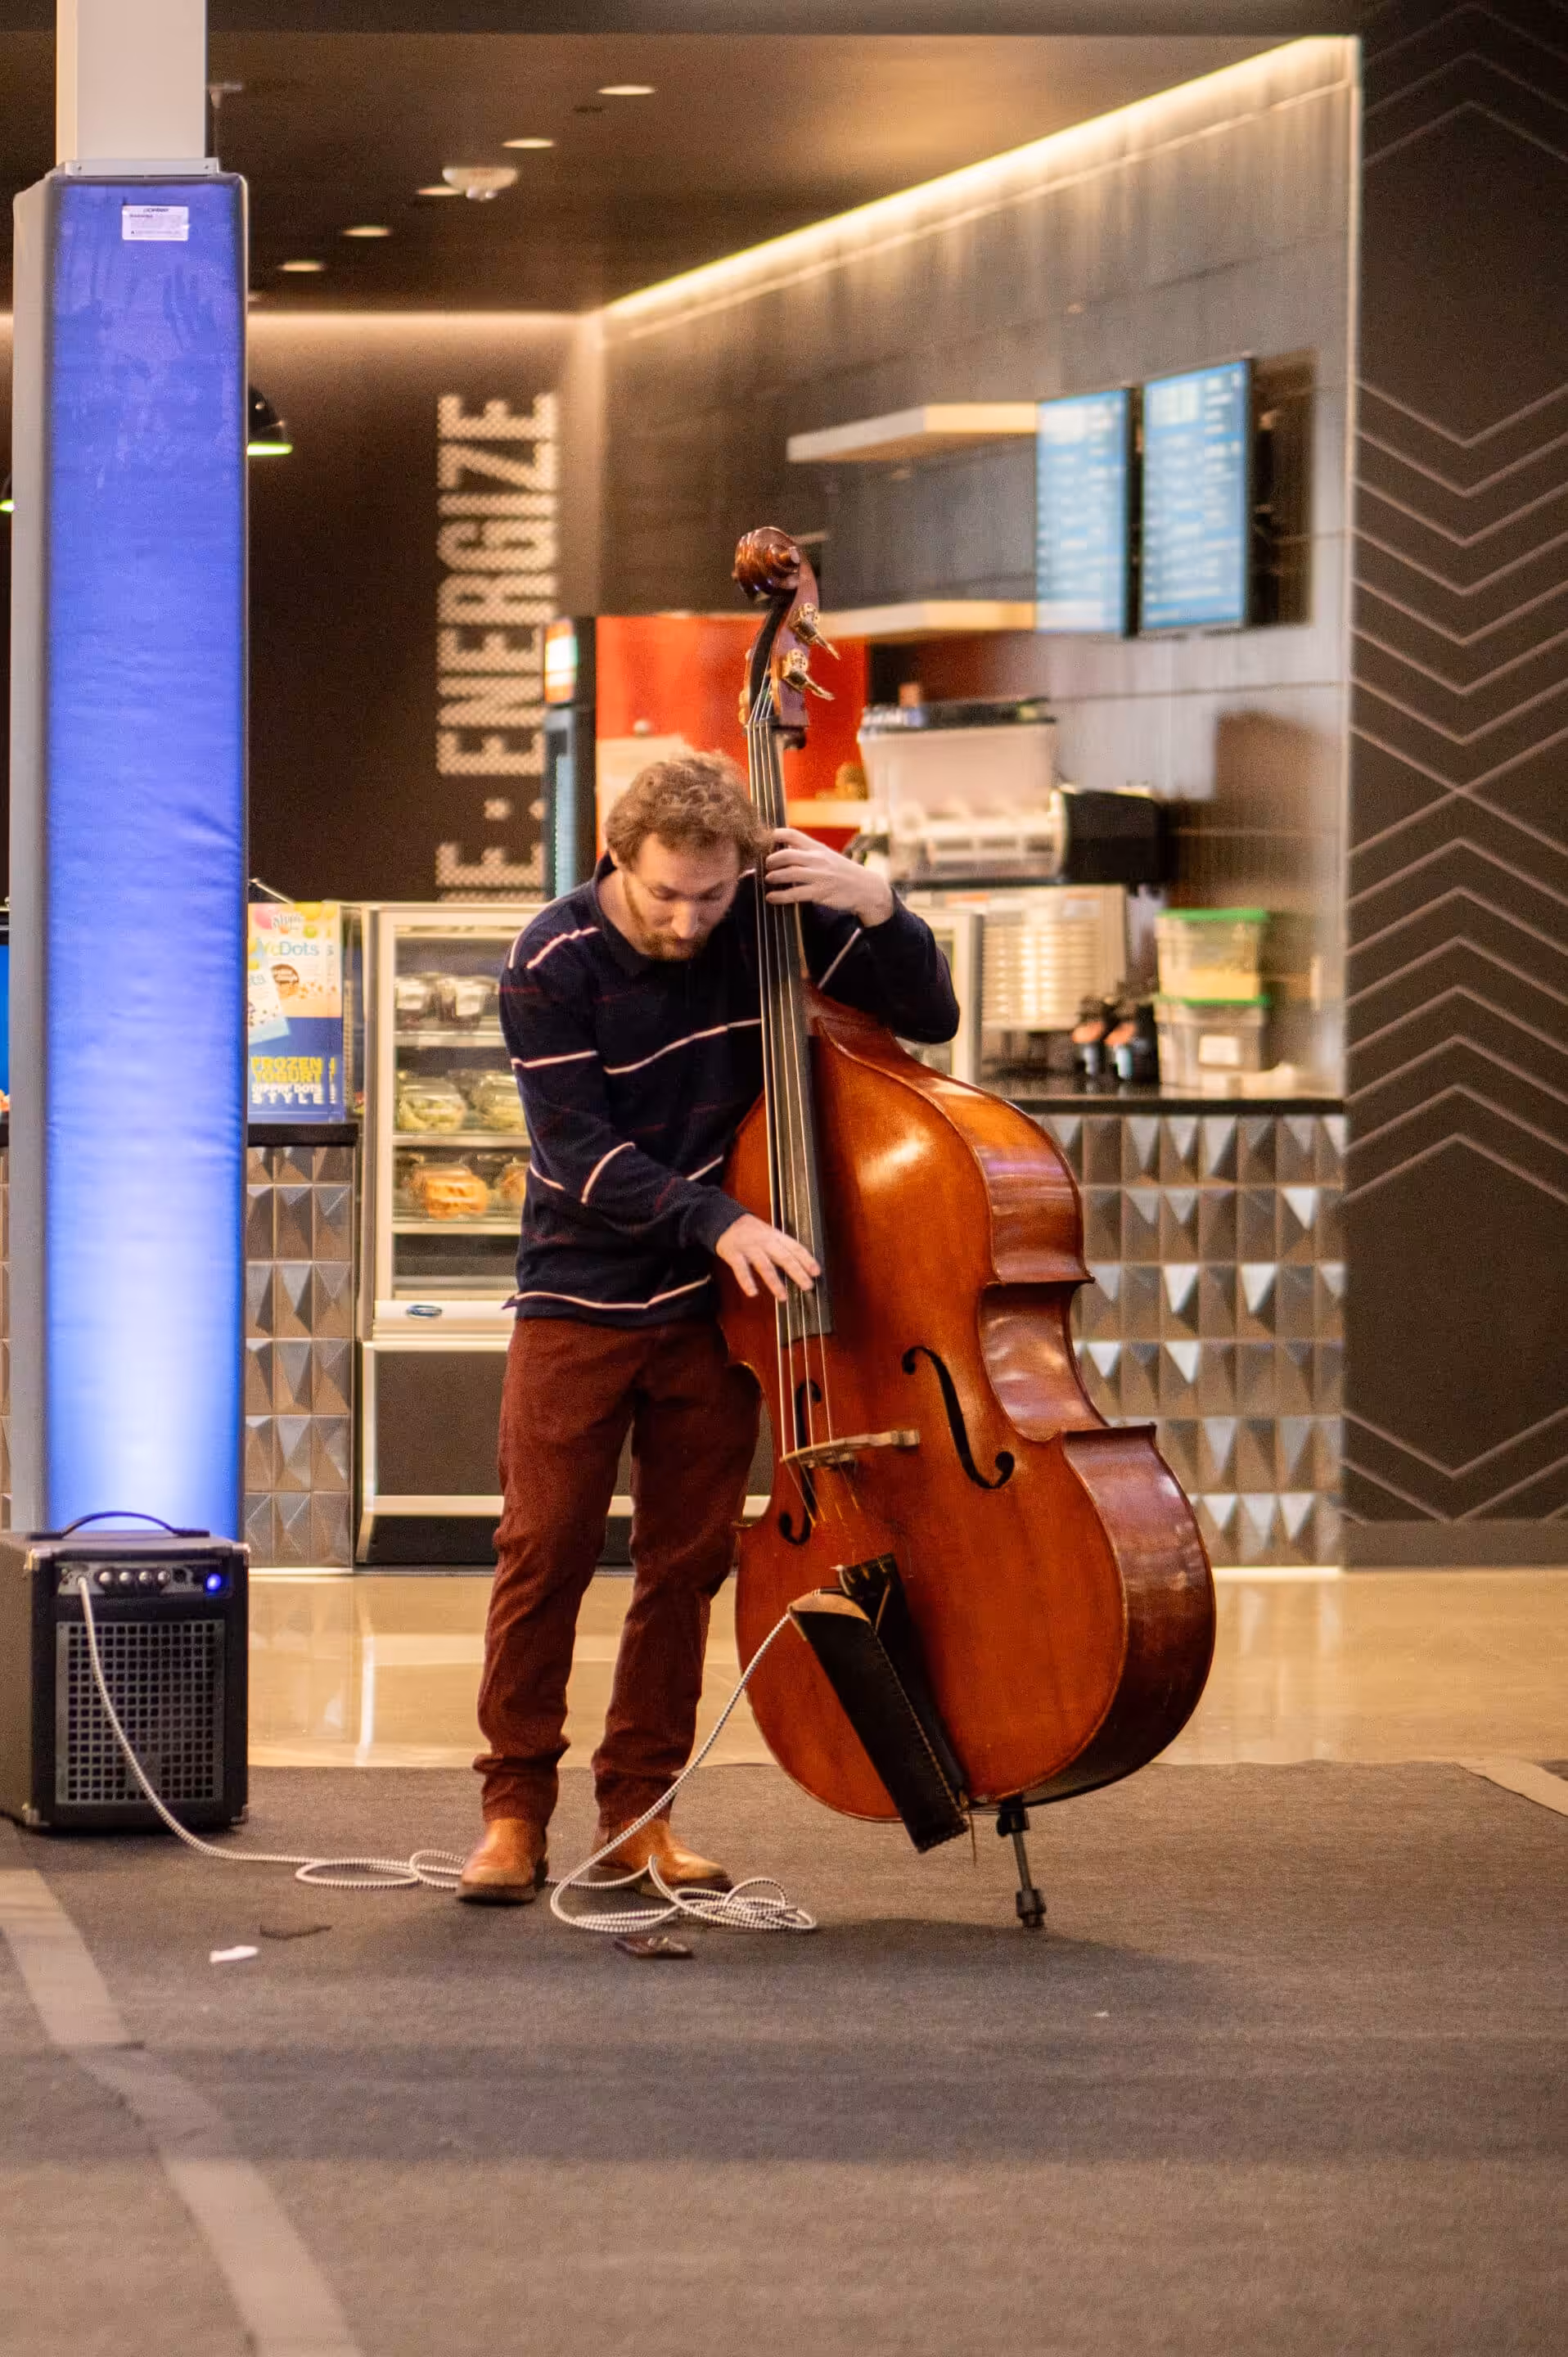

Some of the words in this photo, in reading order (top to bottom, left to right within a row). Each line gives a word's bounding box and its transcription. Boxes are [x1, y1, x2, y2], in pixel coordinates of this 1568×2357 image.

[436, 393, 559, 904] E:ENERGIZE
[250, 1057, 323, 1070] FROZEN
[253, 1068, 322, 1083] YOGURT
[251, 1093, 323, 1104] STYLE
